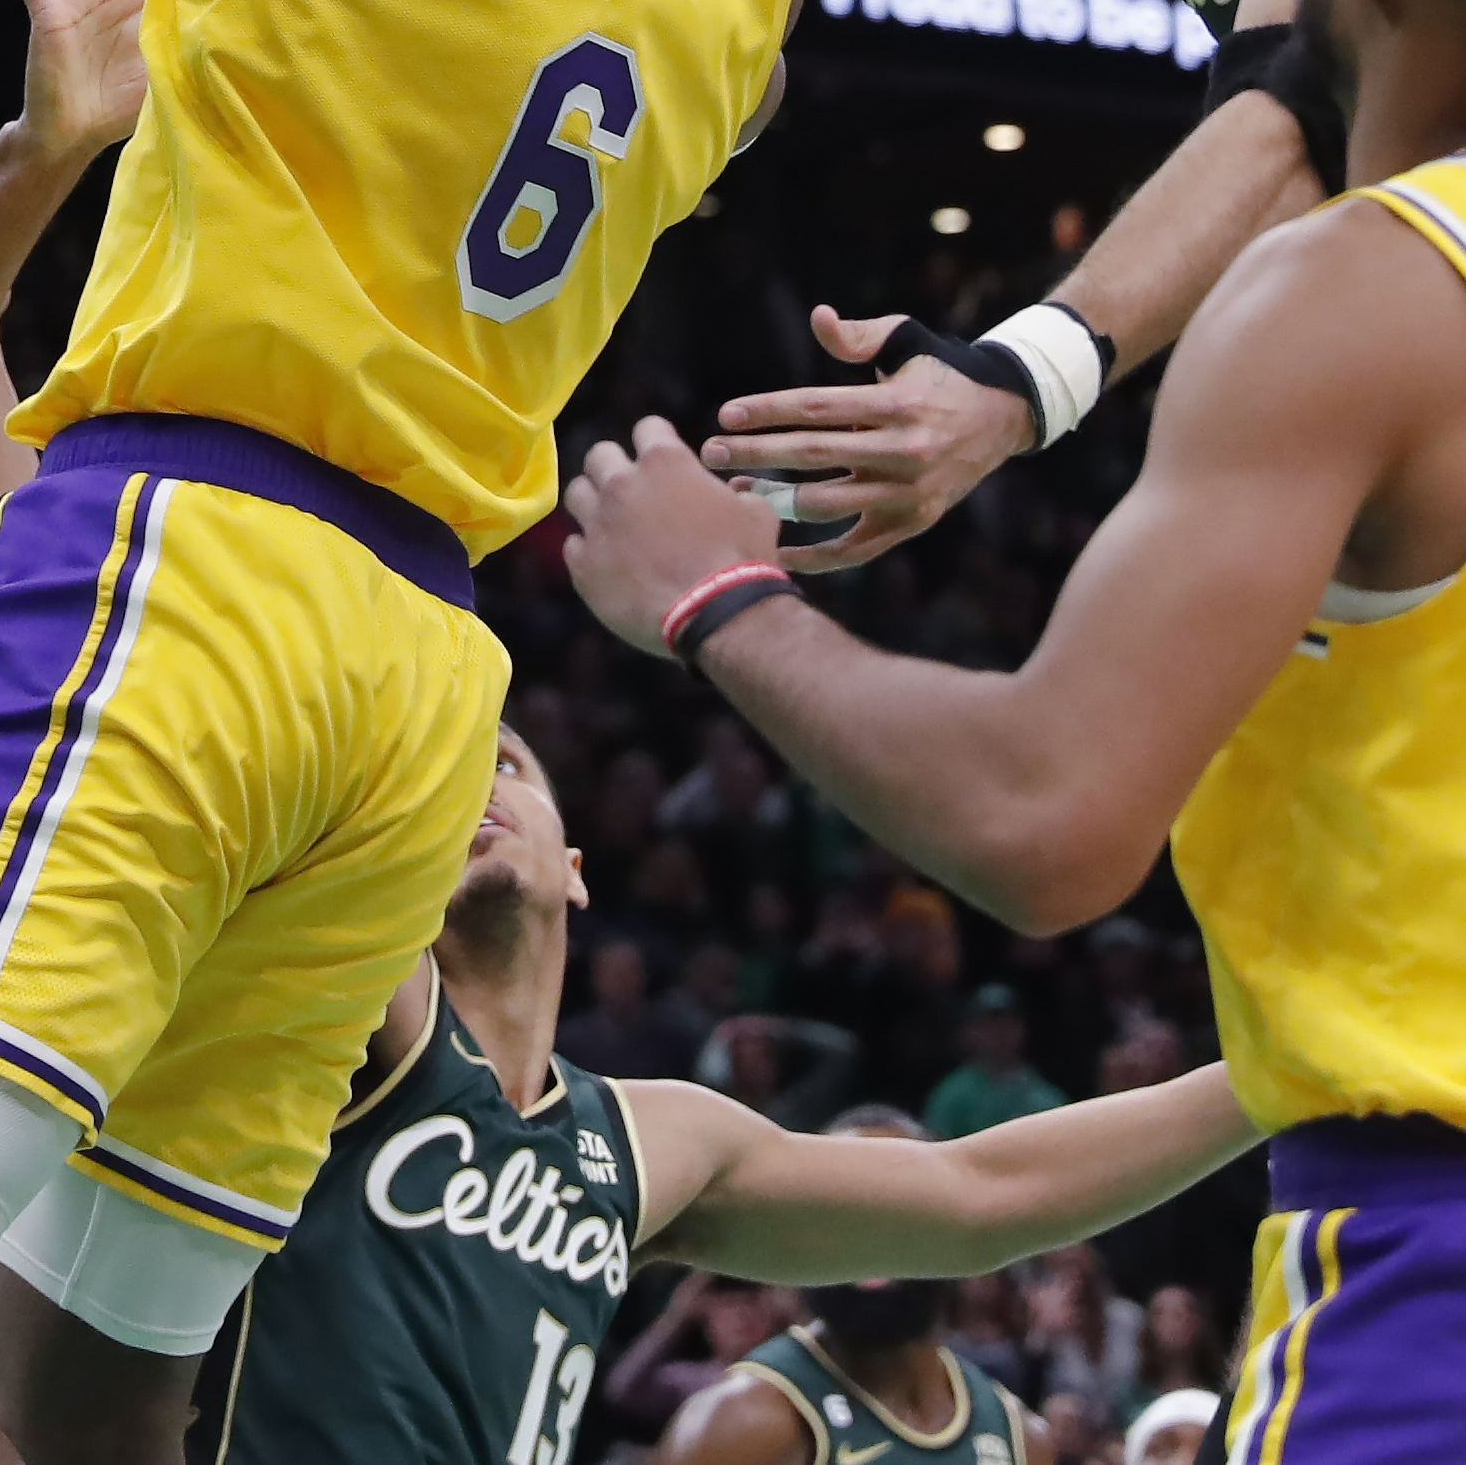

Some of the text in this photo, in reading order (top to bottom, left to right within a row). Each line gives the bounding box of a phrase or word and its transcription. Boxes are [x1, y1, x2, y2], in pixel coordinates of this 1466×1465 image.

[456, 31, 645, 324] 6
[365, 1114, 629, 1298] Celtics
[506, 1308, 597, 1465] 13
